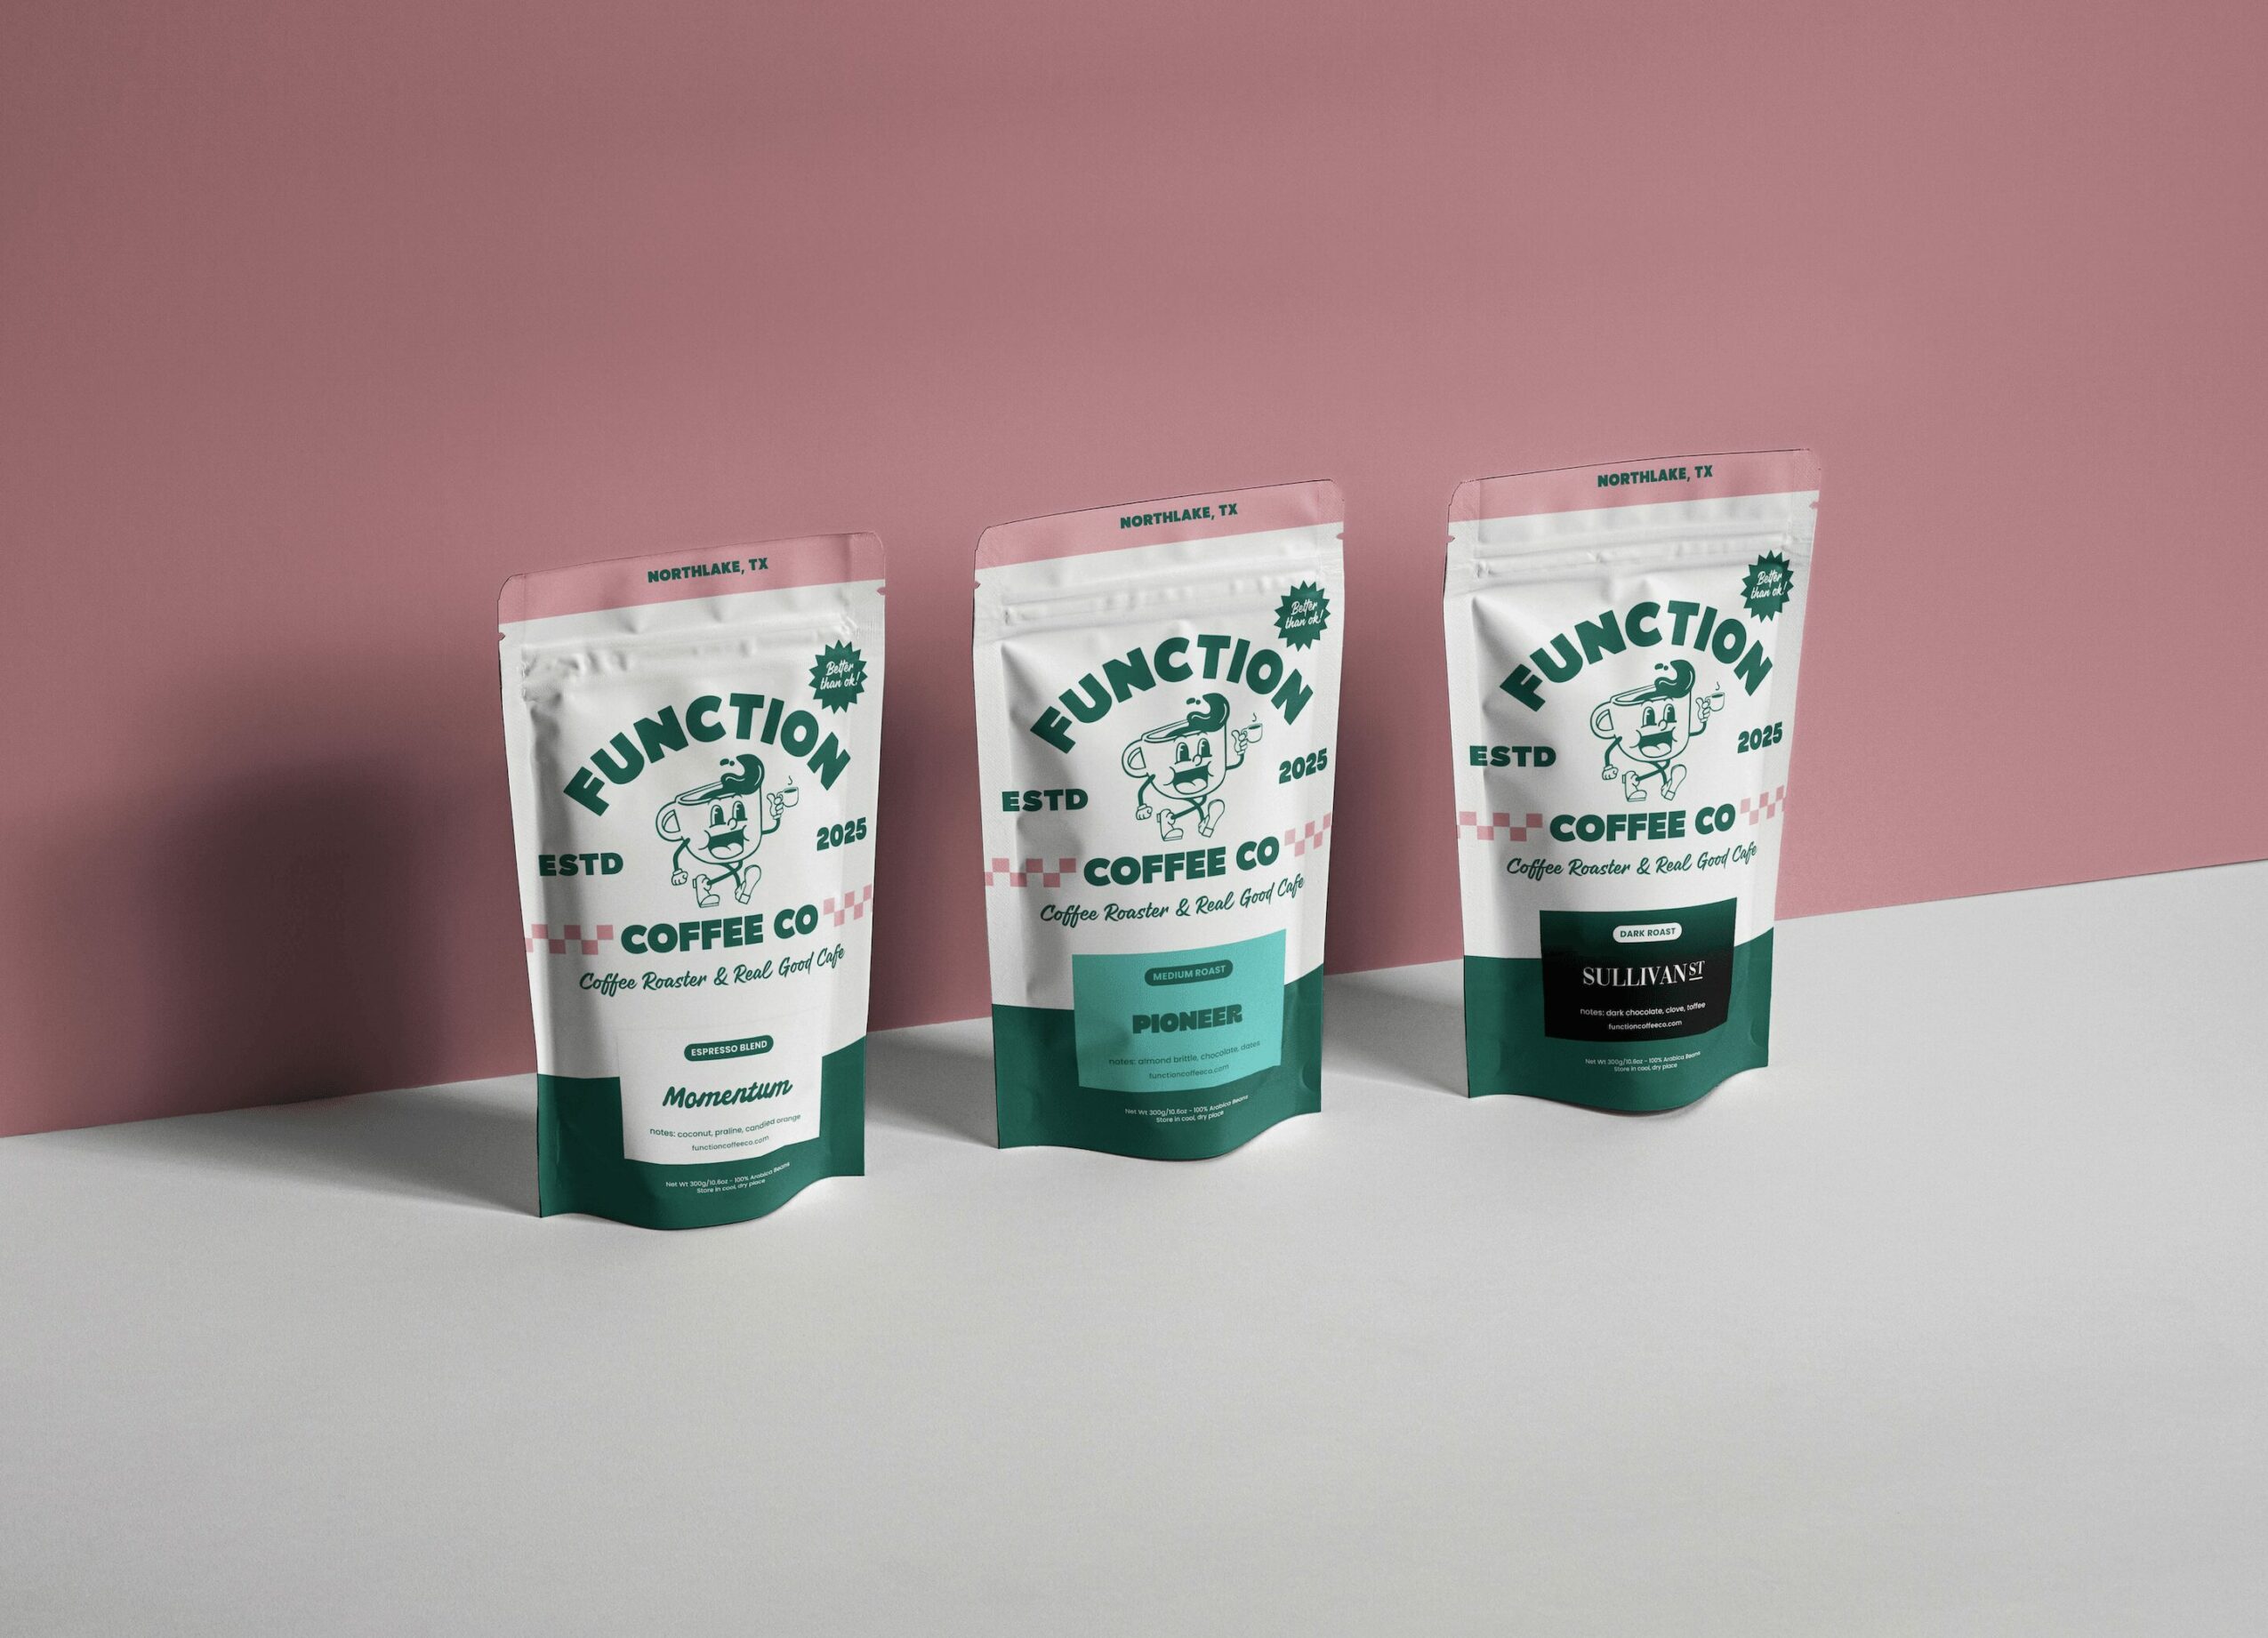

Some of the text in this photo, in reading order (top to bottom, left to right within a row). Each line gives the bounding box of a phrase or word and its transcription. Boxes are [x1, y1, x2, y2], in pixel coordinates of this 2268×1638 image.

[1597, 465, 1713, 487] NORTHLAKE, TX
[1120, 502, 1238, 529] NORTHLAKE, TX
[647, 557, 768, 583] NORTHLAKE, TX
[1757, 569, 1782, 588] Better
[1750, 581, 1788, 599] than ok!
[1284, 609, 1323, 630] than ok!
[1291, 598, 1318, 617] Better
[825, 659, 854, 678] Better
[1500, 600, 1773, 712] FUNCTION
[820, 671, 861, 690] than ok!
[1030, 634, 1314, 754] FUNCTION
[1737, 721, 1783, 754] 2025
[563, 693, 851, 816] FUNCTION
[1278, 748, 1328, 784] 2025
[1469, 745, 1556, 767] ESTD
[1001, 788, 1089, 812] ESTD
[816, 817, 867, 851] 2025
[1549, 803, 1735, 842] COFFEE CO
[539, 852, 623, 877] ESTD
[1083, 836, 1280, 887] COFFEE CO
[1507, 840, 1757, 881] Coffee Roaster & Real Good Cafe
[1040, 873, 1304, 927] Coffee Roaster & Real Good Cafe
[621, 904, 818, 954] COFFEE CO
[1620, 927, 1677, 938] DARK ROAST
[579, 943, 845, 997] Coffee Roaster & Real Good Cafe
[1153, 965, 1226, 981] MEDIUM ROAST
[1582, 960, 1705, 987] SULLIVAN ST
[1132, 1004, 1243, 1034] PIONEER
[1580, 1008, 1604, 1016] notes:
[1606, 1008, 1624, 1016] dark
[1687, 1001, 1706, 1011] toffee
[1608, 1019, 1683, 1031] functioncoffeeco.com
[691, 1040, 768, 1056] ESPRESSO BLEND
[1138, 1056, 1171, 1065] almond
[1240, 1040, 1260, 1050] dates
[1148, 1064, 1230, 1080] functioncoffeeco.com
[662, 1080, 793, 1109] Momentum
[649, 1128, 676, 1137] notes:
[745, 1118, 775, 1132] candied
[776, 1113, 800, 1124] orange
[691, 1135, 769, 1152] functioncoffeeco.com
